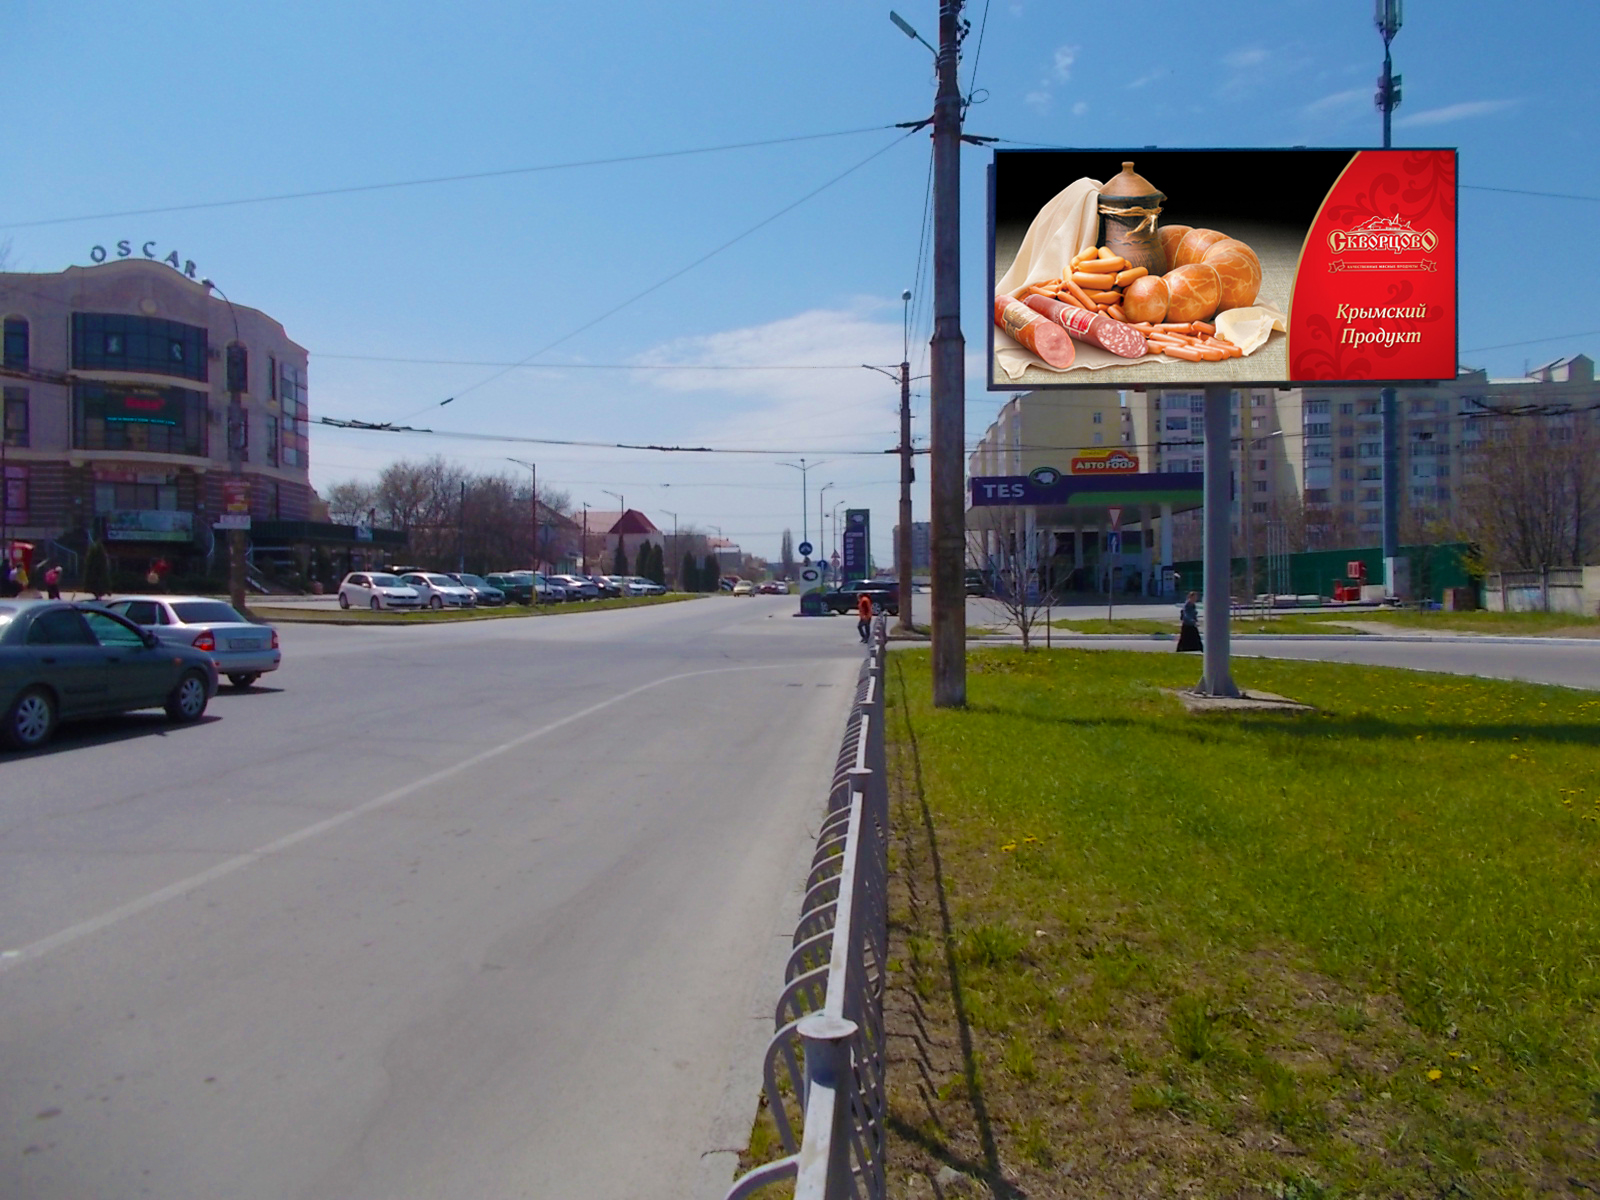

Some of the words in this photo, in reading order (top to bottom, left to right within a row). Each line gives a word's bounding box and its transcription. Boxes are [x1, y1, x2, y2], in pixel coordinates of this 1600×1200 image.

[1328, 230, 1438, 253] СКВОРЦОВО
[90, 240, 197, 279] OSCAR
[1336, 303, 1428, 323] Крымский
[1341, 327, 1422, 348] Продукт
[982, 483, 1025, 498] TES
